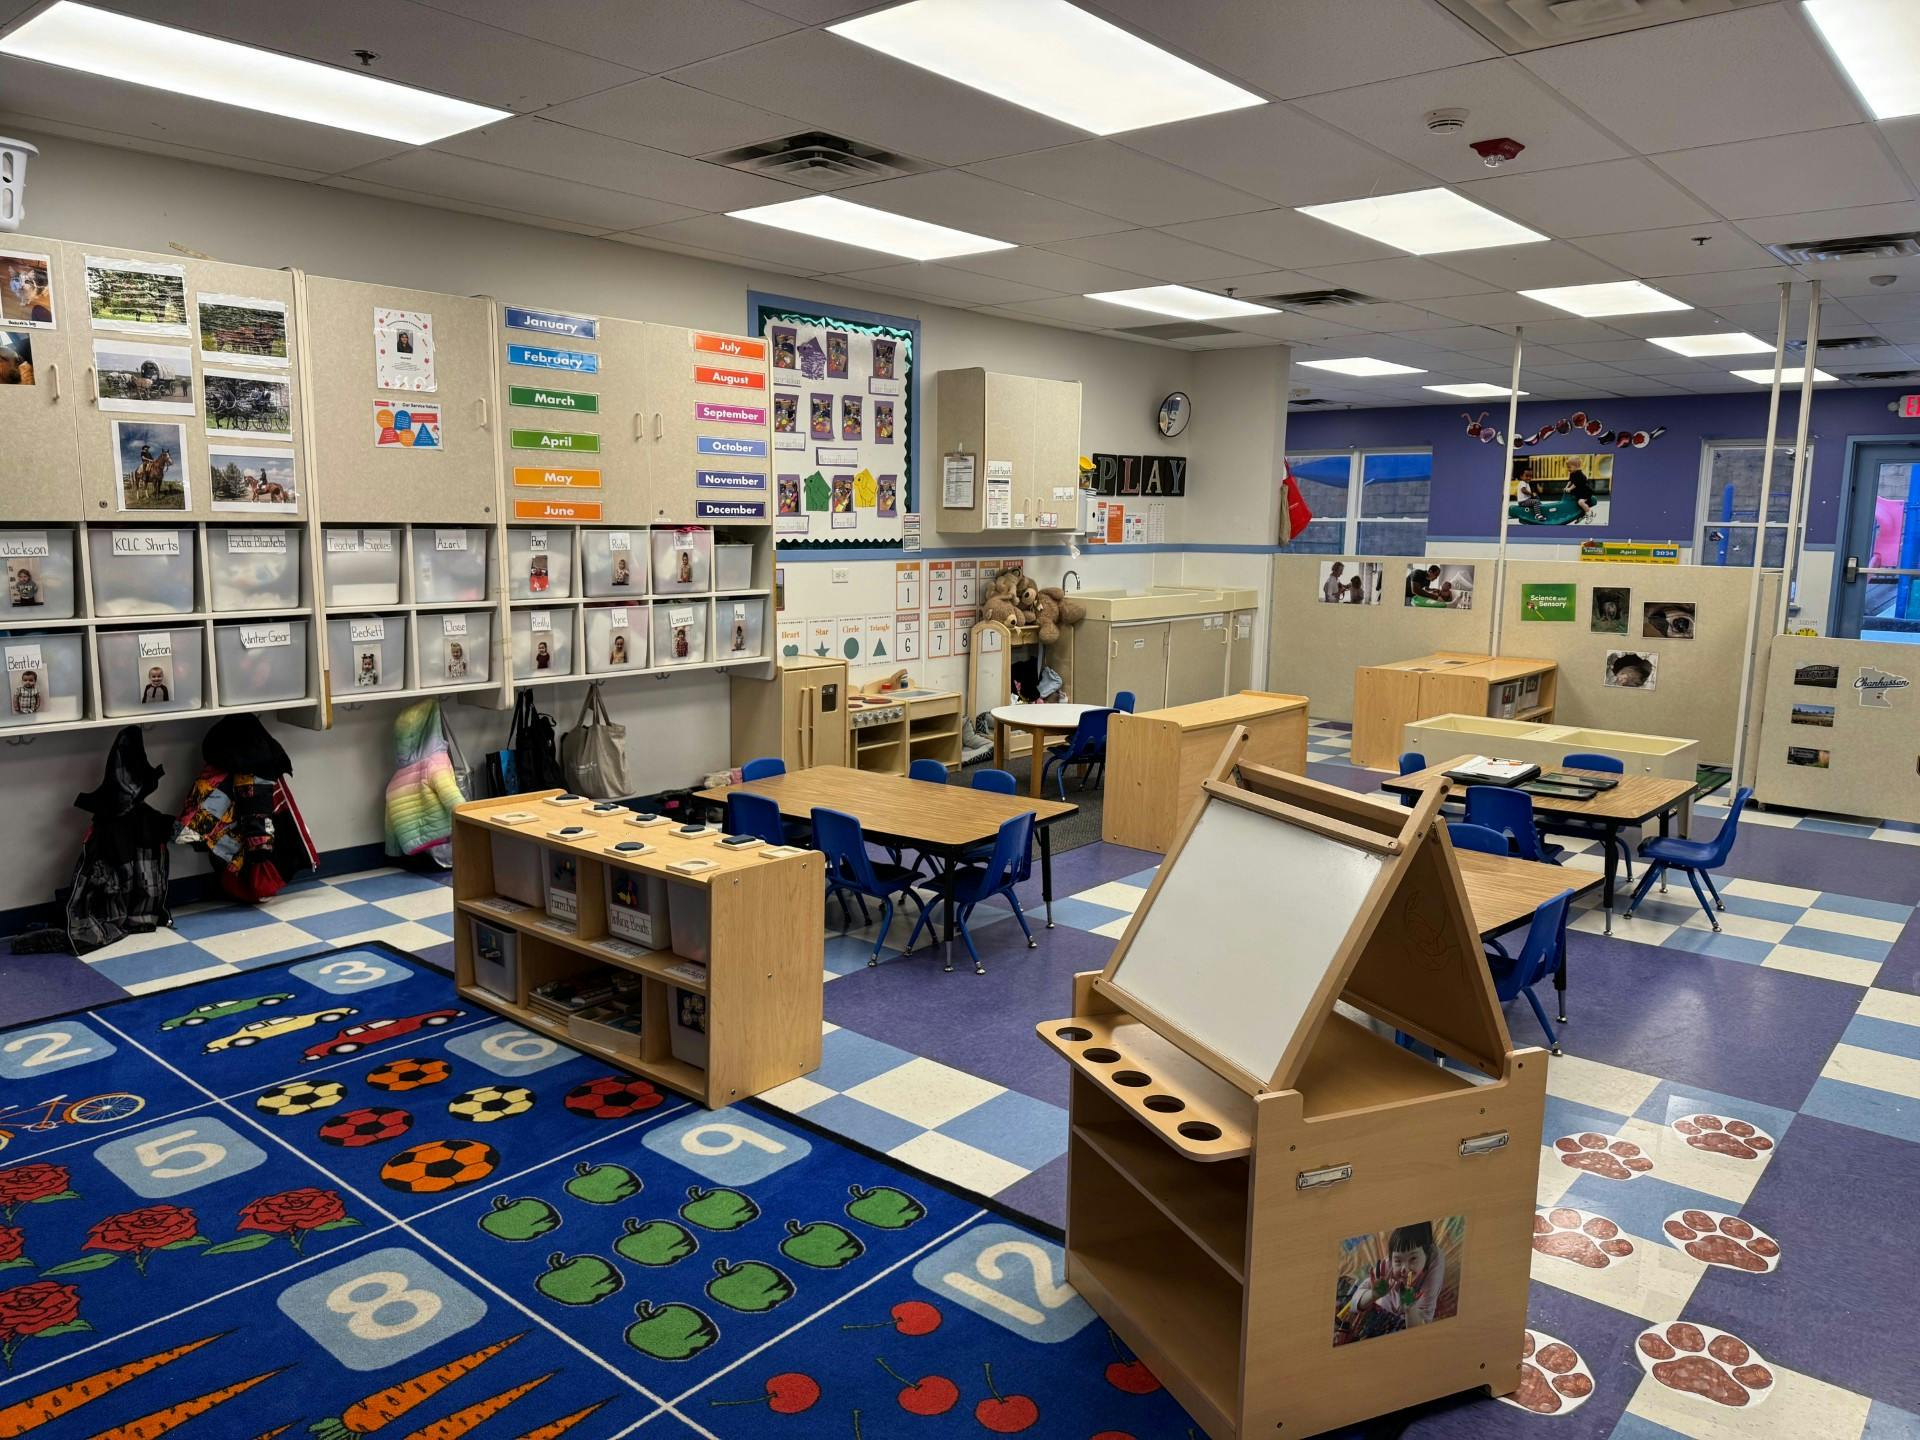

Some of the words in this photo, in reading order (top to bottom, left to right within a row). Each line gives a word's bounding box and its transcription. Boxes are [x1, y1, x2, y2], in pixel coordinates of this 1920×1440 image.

[523, 315, 578, 333] January
[719, 341, 741, 354] July
[524, 351, 583, 368] February
[712, 372, 749, 385] August
[534, 393, 575, 406] March
[703, 407, 758, 421] September
[541, 435, 572, 448] April
[712, 441, 753, 453] October
[544, 472, 573, 485] May
[705, 474, 758, 486] November
[1096, 456, 1185, 494] PLAY
[544, 505, 574, 517] June
[706, 504, 757, 516] December
[1, 541, 47, 555] Jackson
[114, 537, 140, 552] KCLC
[146, 537, 179, 553] Shirts
[327, 537, 357, 551] Teacher
[906, 587, 910, 604] 1
[937, 586, 943, 602] 2
[962, 584, 969, 600] 3
[1539, 600, 1566, 609] Sensory
[351, 624, 382, 638] Beckett
[782, 631, 800, 640] Heart
[816, 628, 829, 637] Star
[842, 625, 860, 634] Circle
[870, 624, 891, 633] Triangle
[242, 633, 266, 645] Winter
[268, 632, 290, 644] Gear
[905, 637, 911, 653] 6
[937, 635, 943, 651] 7
[962, 632, 968, 648] 8
[141, 643, 171, 656] Keaton
[8, 656, 40, 671] Bentley
[1854, 676, 1910, 690] Chanhassen
[319, 960, 386, 984] 3
[4, 1032, 92, 1067] 2
[481, 1030, 558, 1062] 6
[680, 1123, 787, 1156] 9
[135, 1130, 228, 1178] 5
[943, 1241, 1078, 1324] 12
[326, 1271, 442, 1340] 8
